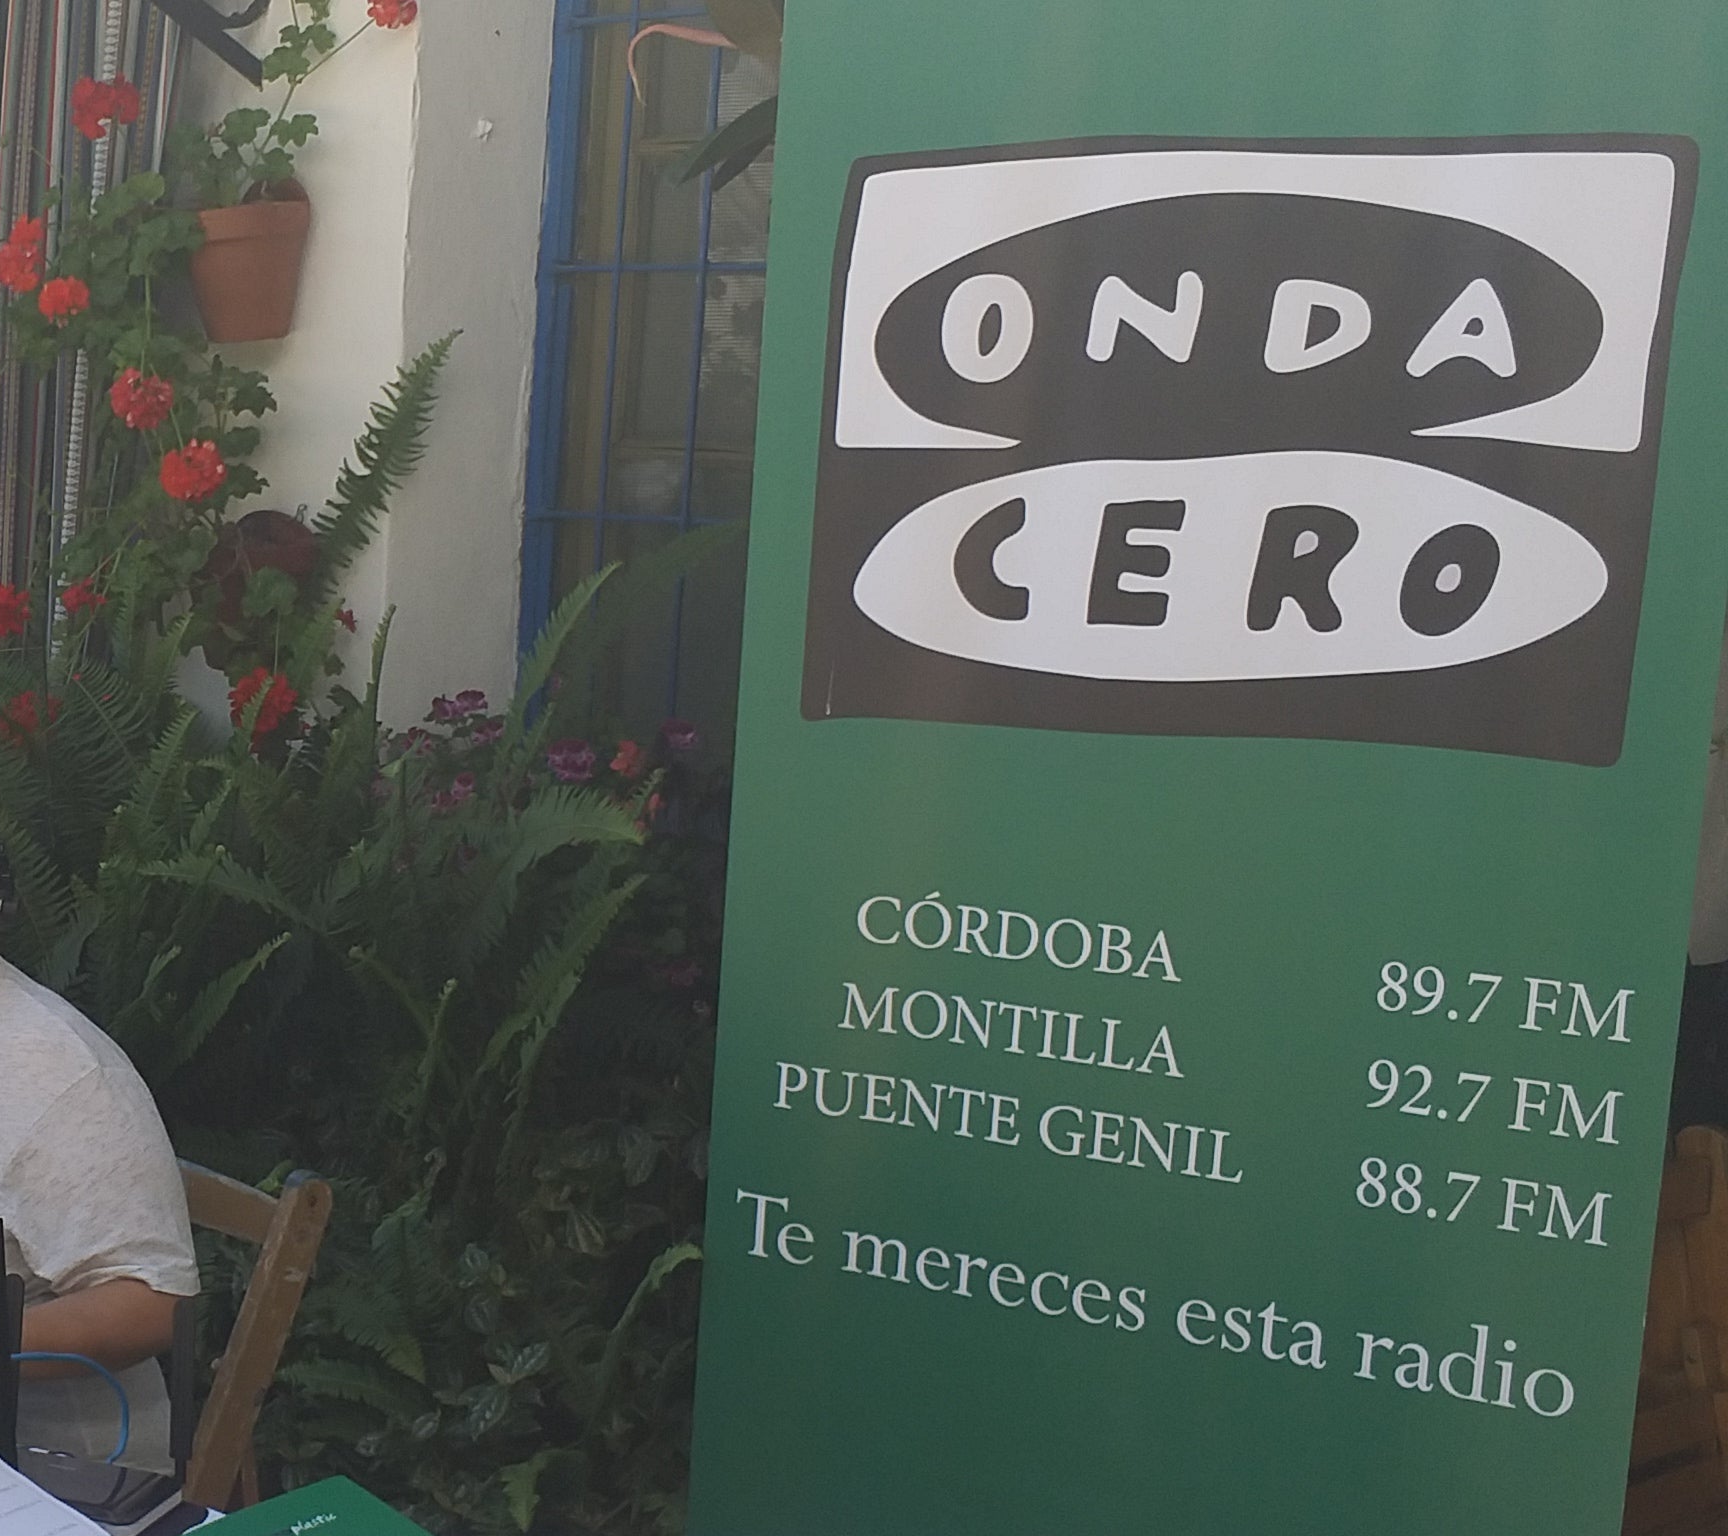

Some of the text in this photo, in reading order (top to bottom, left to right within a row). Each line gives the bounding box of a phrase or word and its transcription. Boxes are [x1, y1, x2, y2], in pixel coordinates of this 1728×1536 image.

[940, 270, 1517, 383] ONDA
[952, 496, 1502, 638] CERO
[856, 891, 1637, 1044] CÓRDOBA 89.7 FM
[837, 981, 1625, 1146] MONTILLA 92.7 FM
[772, 1061, 1613, 1248] PUENTE GENIL 88.7 FM
[736, 1187, 1576, 1417] Te mereces esta radio
